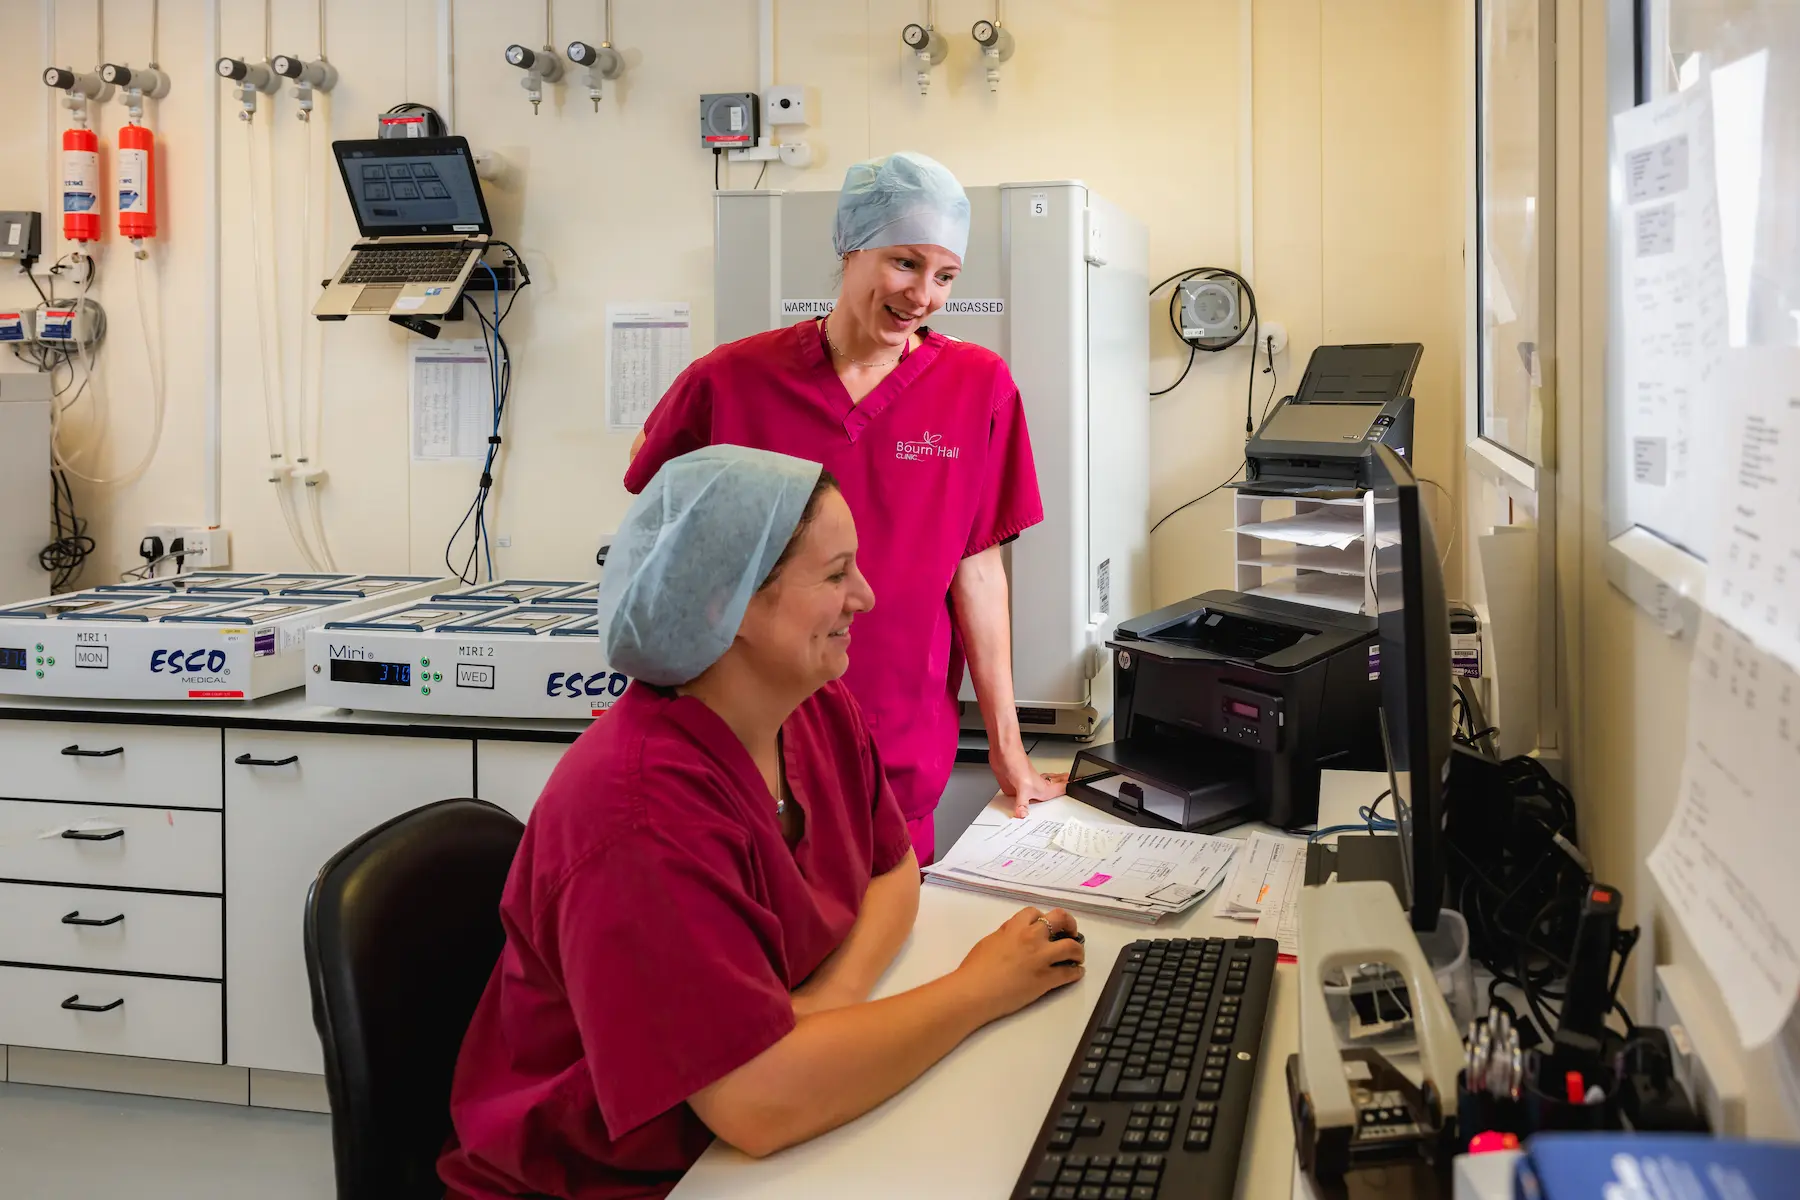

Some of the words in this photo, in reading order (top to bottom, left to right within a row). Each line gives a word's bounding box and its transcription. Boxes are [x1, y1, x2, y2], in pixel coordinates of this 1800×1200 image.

[1035, 203, 1043, 214] 5
[784, 302, 833, 313] WARMING
[945, 302, 1004, 313] UNGASSED
[896, 441, 933, 455] Bourn
[937, 446, 960, 459] Hall
[895, 452, 918, 461] CLINIC
[76, 632, 100, 642] MIRI
[103, 633, 108, 642] 1
[329, 644, 364, 660] Miri
[459, 646, 484, 656] MIRI
[487, 647, 494, 657] 2
[78, 652, 103, 663] MON
[150, 649, 226, 674] ESCO
[460, 670, 488, 683] WED
[546, 672, 628, 698] ESCO
